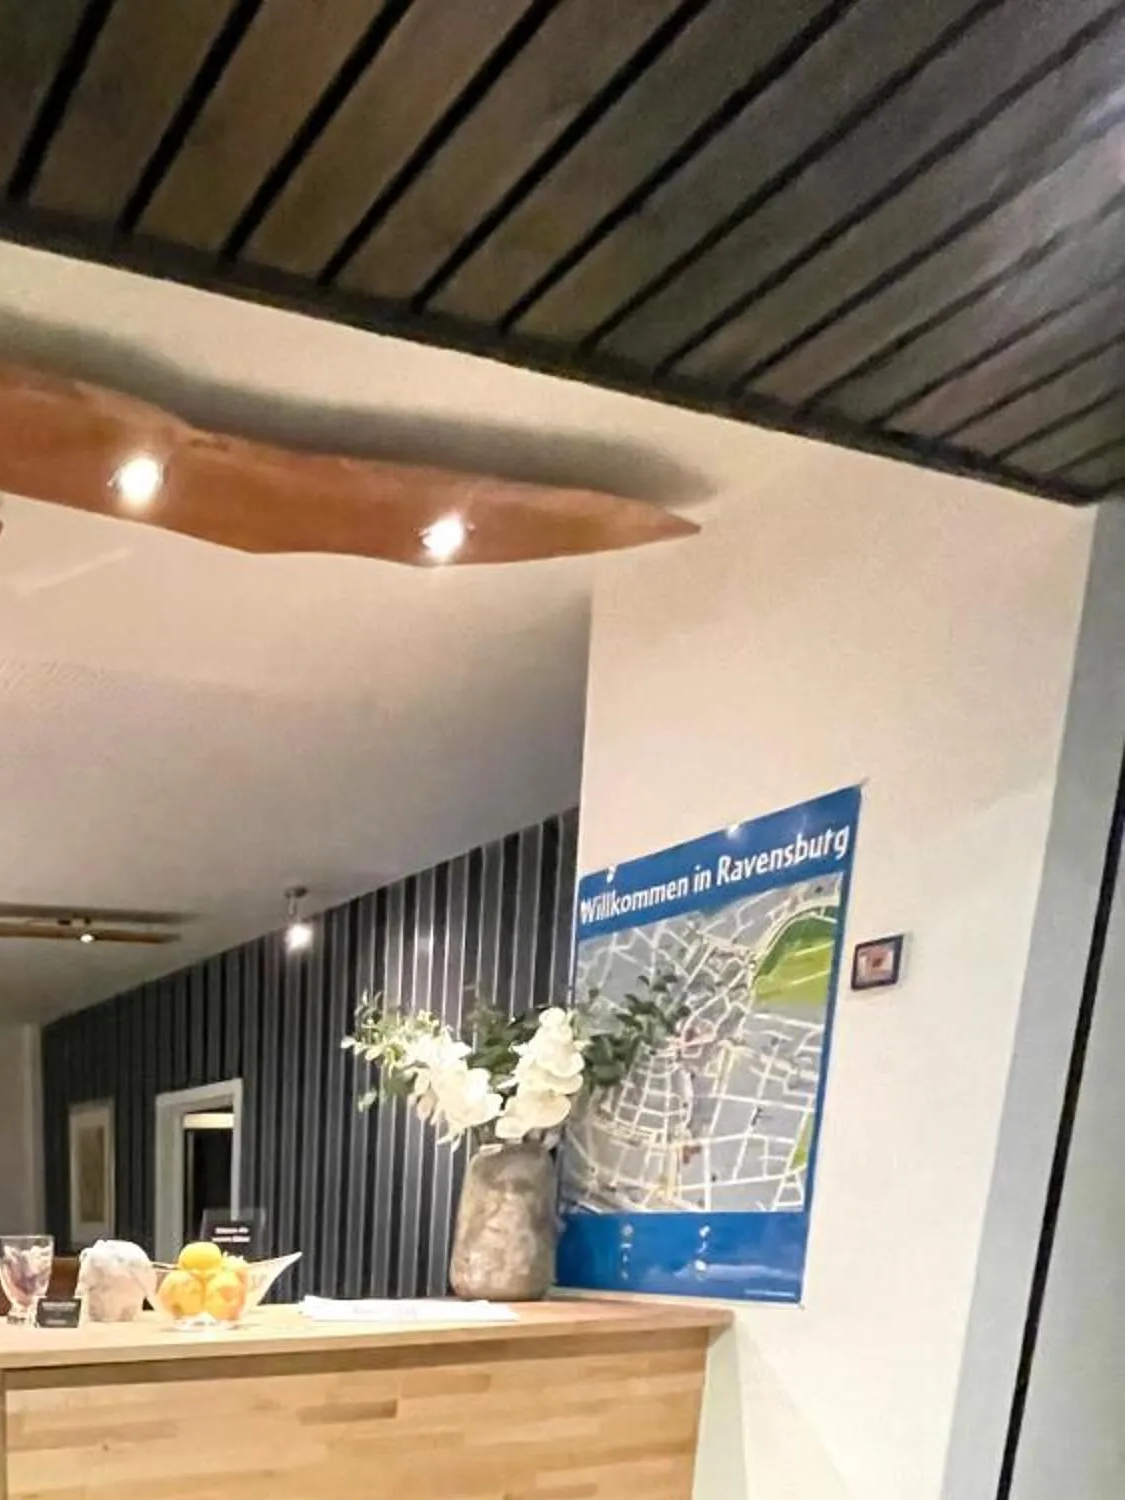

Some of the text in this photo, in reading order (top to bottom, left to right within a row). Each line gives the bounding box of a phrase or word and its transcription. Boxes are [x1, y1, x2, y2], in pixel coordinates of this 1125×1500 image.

[579, 825, 850, 925] Willkommen in Ravensburg
